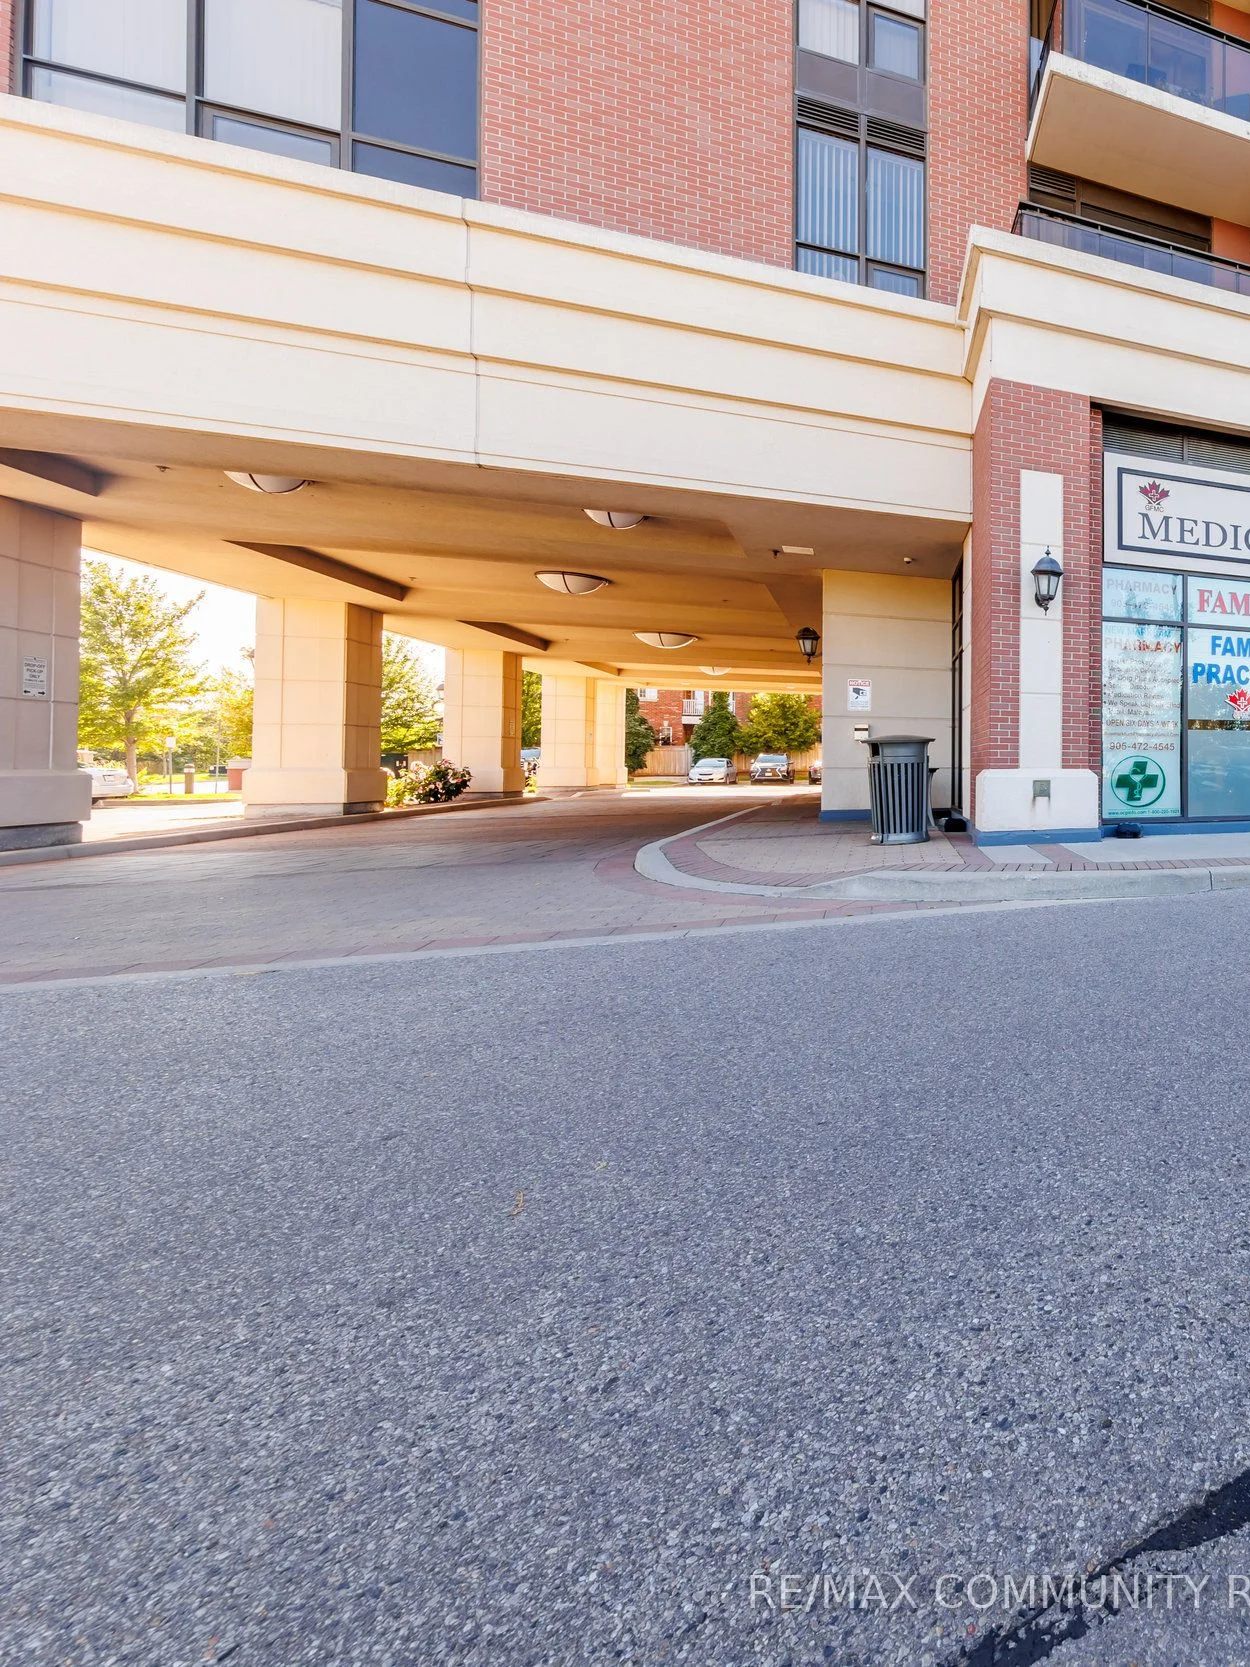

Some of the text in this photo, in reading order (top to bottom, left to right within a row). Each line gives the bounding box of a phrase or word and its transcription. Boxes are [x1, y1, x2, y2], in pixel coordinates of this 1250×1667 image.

[1144, 504, 1165, 513] GFMC
[1106, 579, 1177, 595] PHARMACY
[1106, 719, 1124, 727] OPEN
[1109, 742, 1175, 751] 905-472-4545
